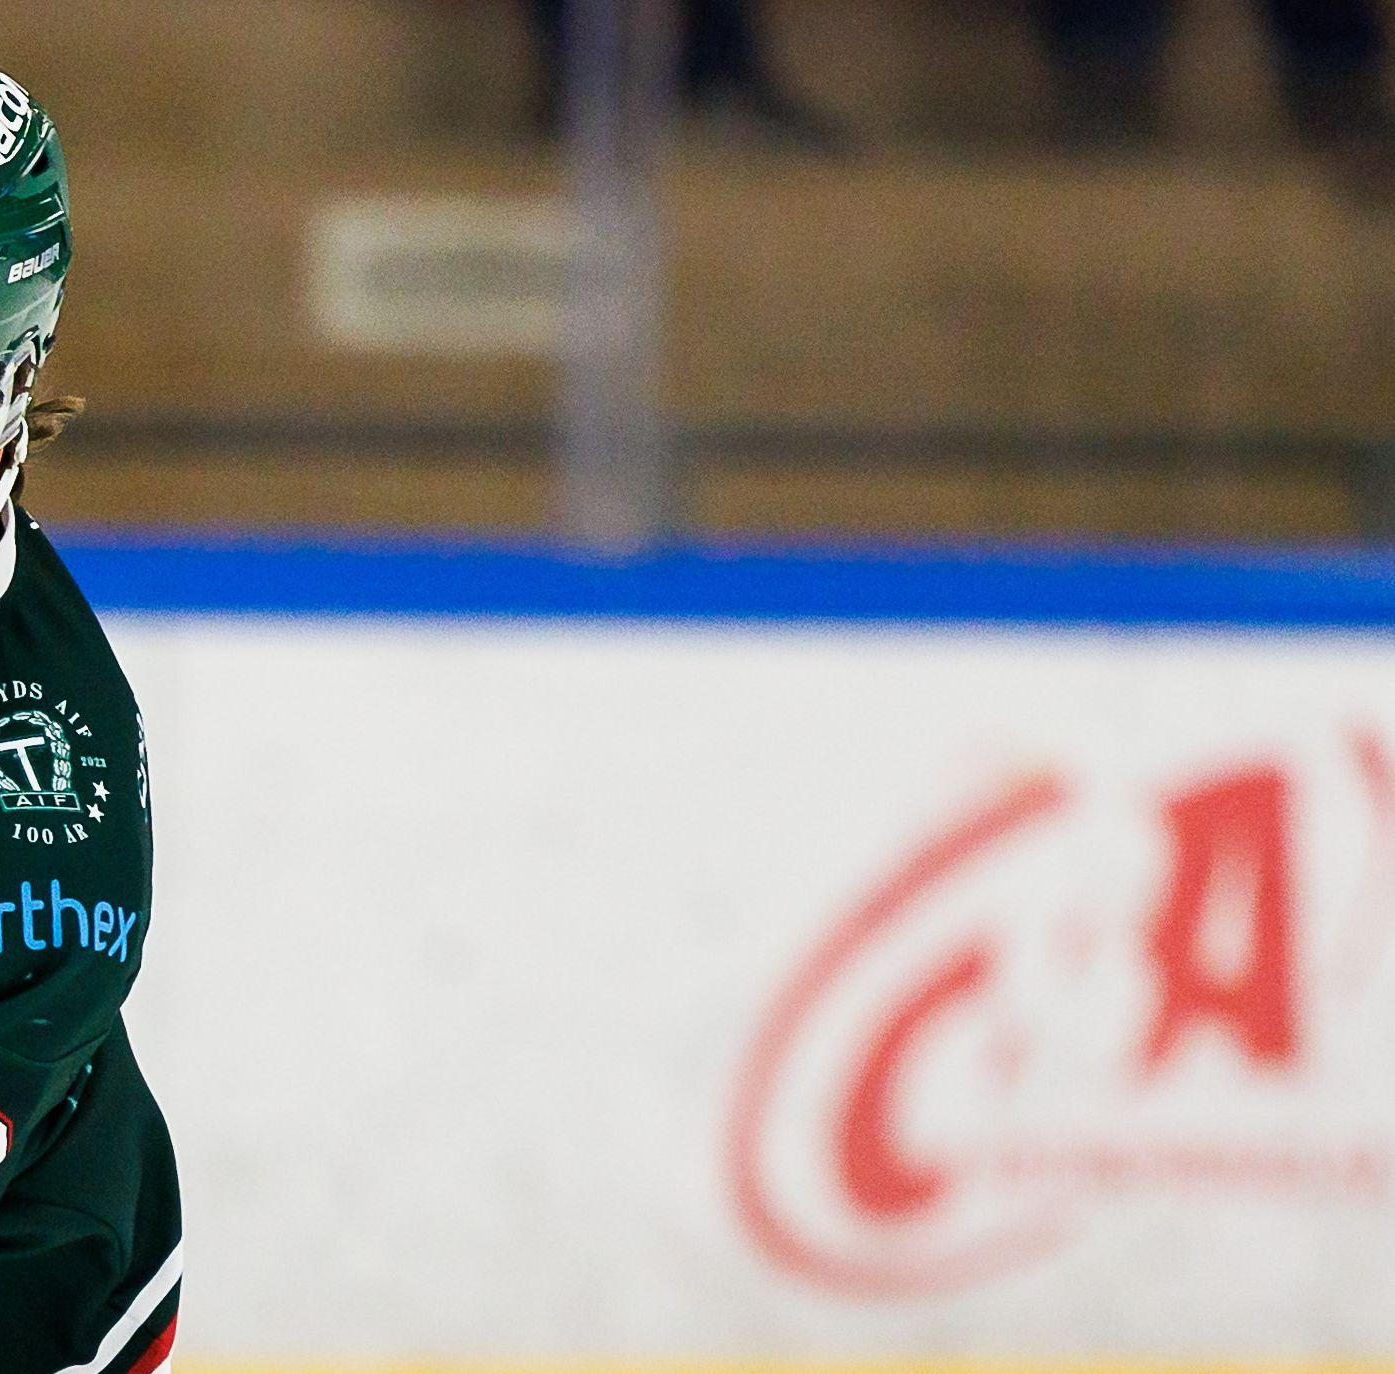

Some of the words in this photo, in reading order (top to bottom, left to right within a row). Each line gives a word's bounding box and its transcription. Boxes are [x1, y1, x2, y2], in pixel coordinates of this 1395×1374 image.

[55, 699, 93, 739] AIF
[16, 794, 67, 807] AIF
[11, 823, 55, 845] 100
